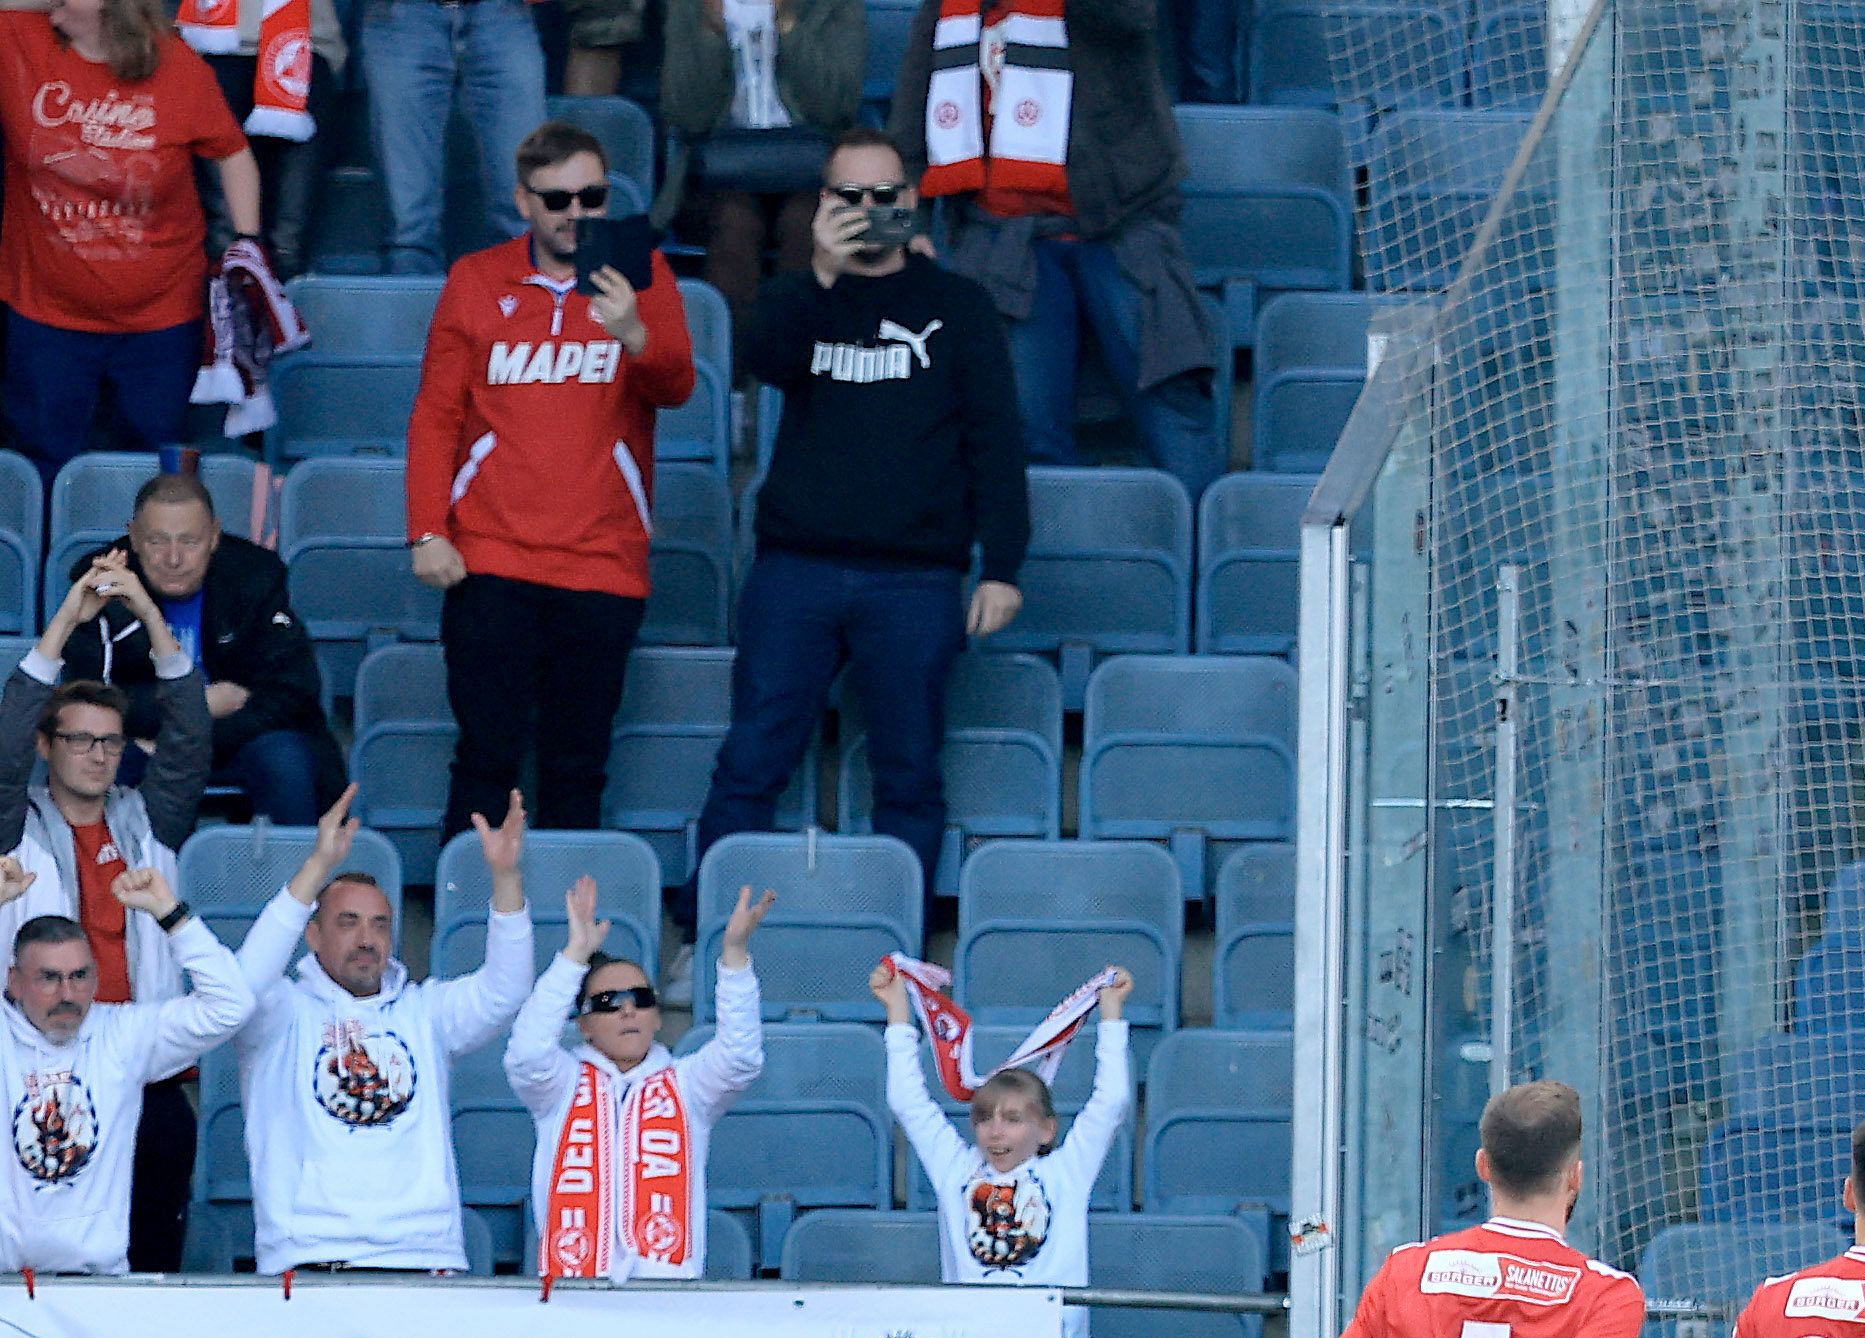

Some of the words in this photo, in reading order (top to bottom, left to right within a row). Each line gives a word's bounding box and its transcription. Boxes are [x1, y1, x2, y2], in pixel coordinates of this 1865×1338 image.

[487, 341, 622, 385] MAPEI
[811, 341, 911, 383] PUMA
[1507, 1263, 1572, 1293] SALANETTIS
